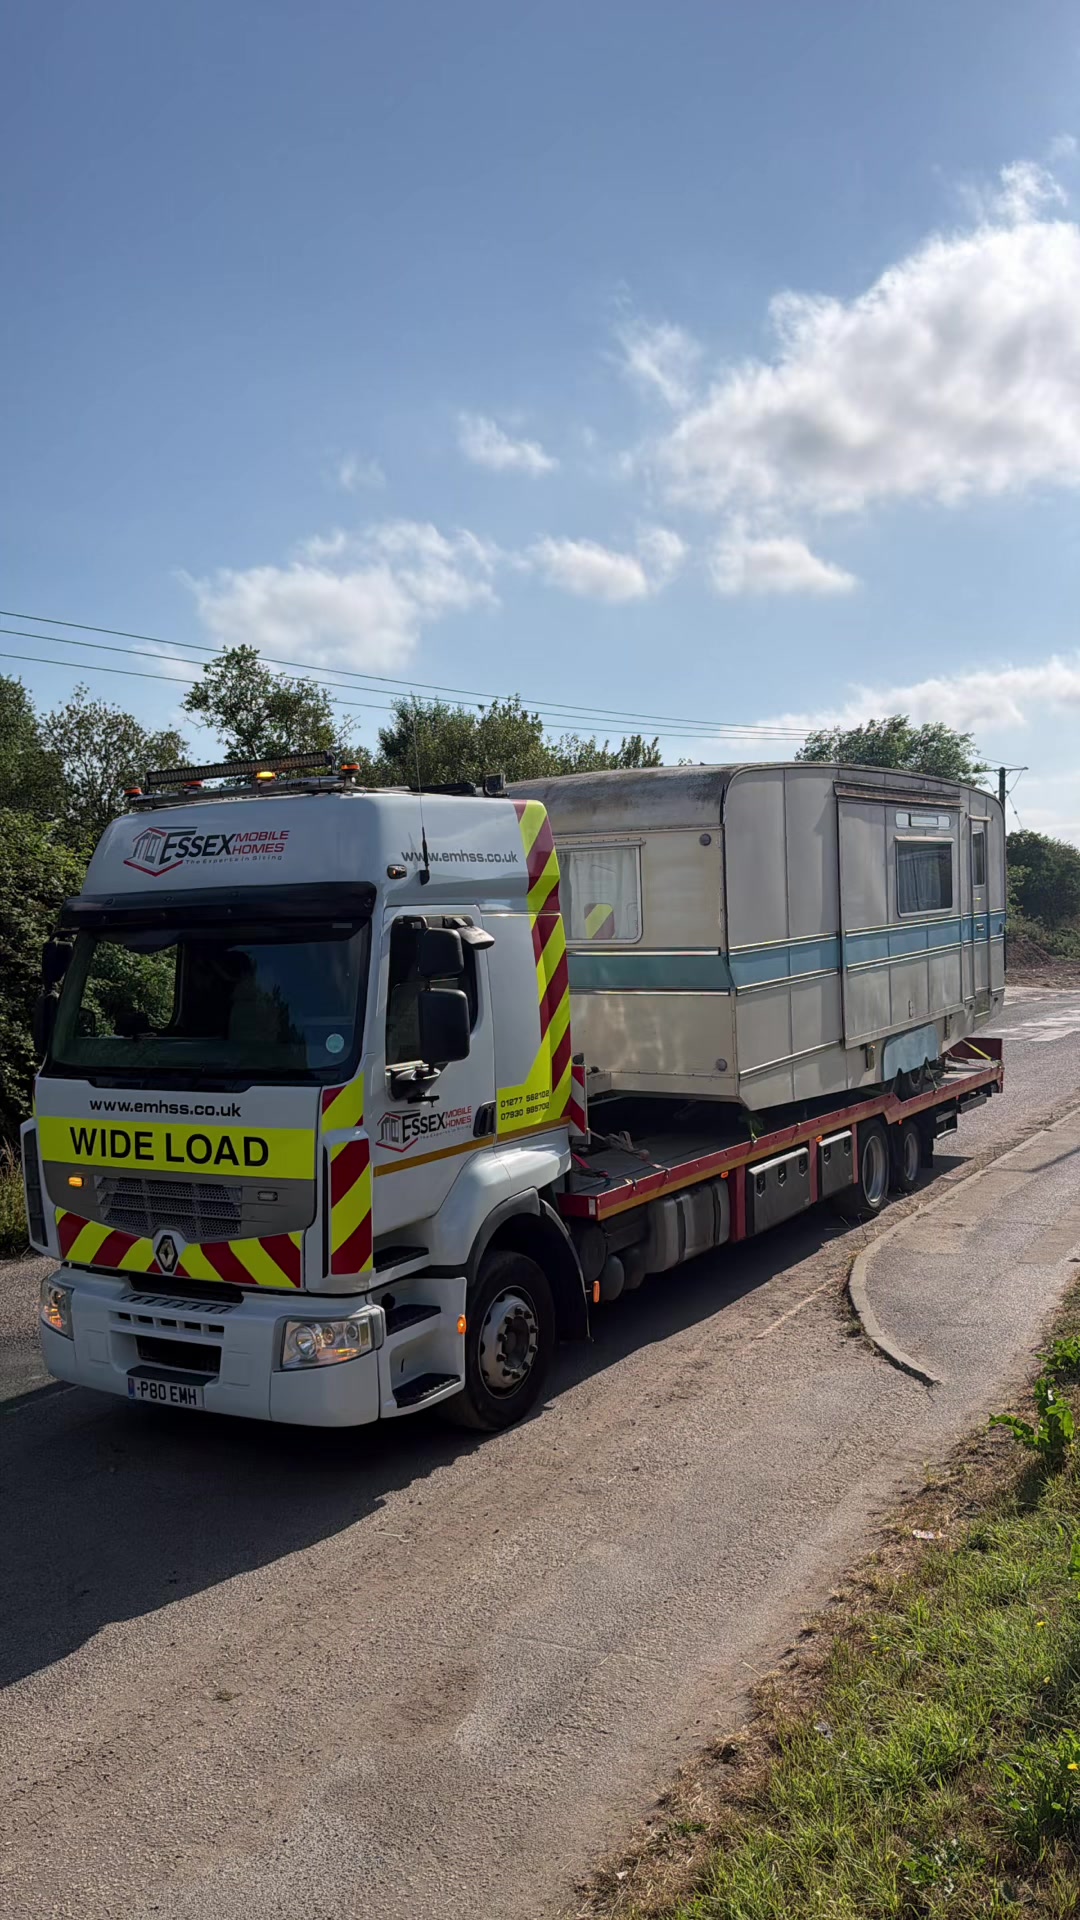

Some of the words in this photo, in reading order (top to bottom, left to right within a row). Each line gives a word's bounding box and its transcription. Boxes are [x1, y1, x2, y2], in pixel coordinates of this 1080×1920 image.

[159, 830, 236, 865] ESSEX
[235, 830, 290, 842] MOBILE
[232, 843, 285, 855] HOMES
[401, 850, 518, 863] www.emhss.co.uk
[90, 1100, 241, 1117] www.emhss.co.uk
[501, 1097, 523, 1107] 01277
[445, 1116, 471, 1128] HOMES
[501, 1109, 523, 1120] 07930
[403, 1111, 446, 1143] ESSEX
[445, 1106, 472, 1119] MOBILE
[69, 1126, 154, 1161] WIDE
[165, 1132, 269, 1167] LOAD
[141, 1381, 166, 1400] P80
[170, 1386, 197, 1405] EMH
